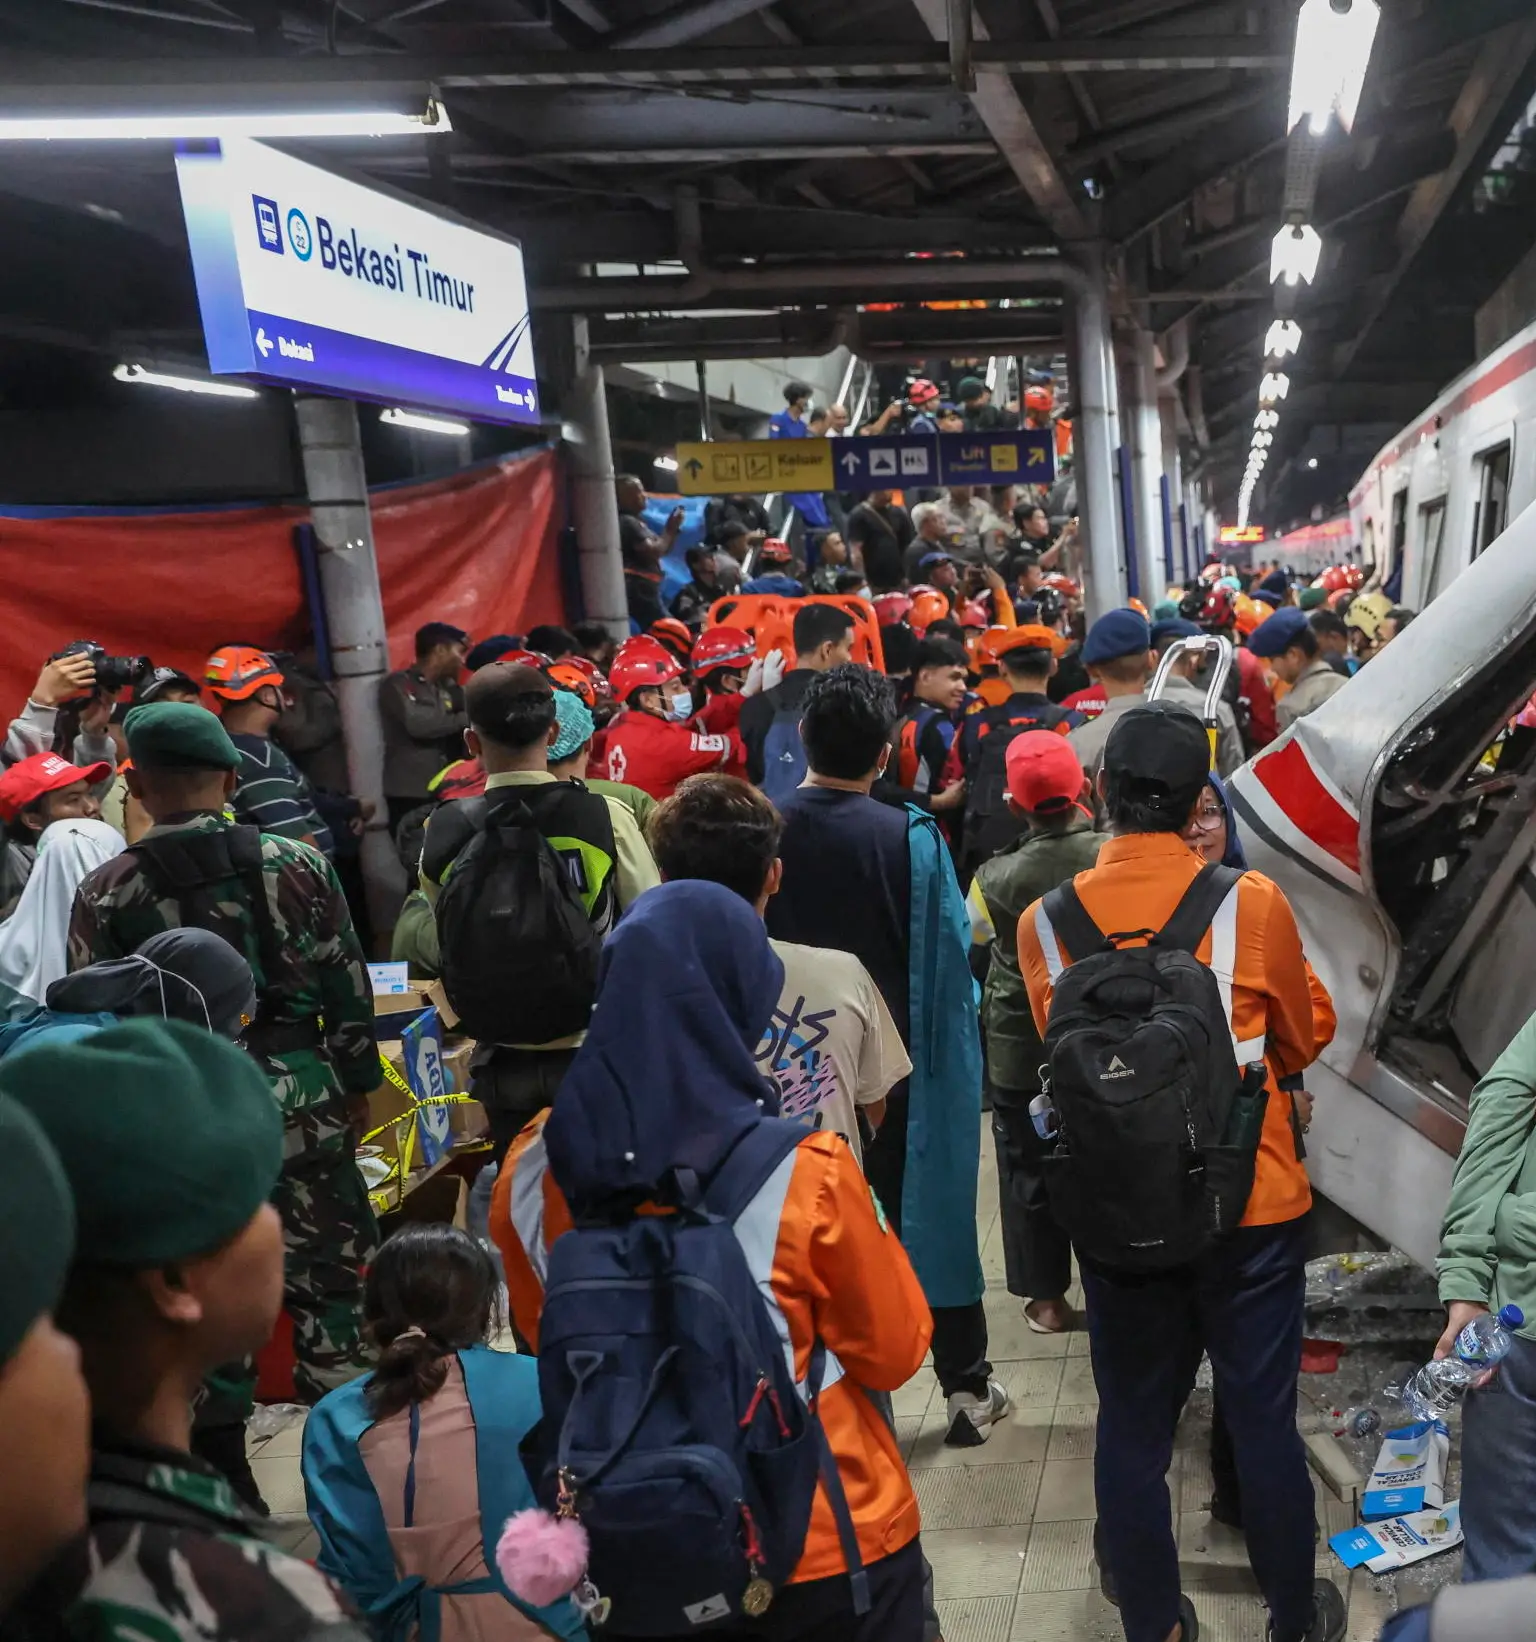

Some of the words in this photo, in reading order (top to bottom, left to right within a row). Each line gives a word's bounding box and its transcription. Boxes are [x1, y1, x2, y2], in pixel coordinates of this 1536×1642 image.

[315, 216, 405, 293] Bekasi
[407, 248, 474, 313] Timur
[1376, 1475, 1422, 1485] CERVICAL
[1380, 1523, 1407, 1548] CERVICAL
[1393, 1525, 1416, 1546] COLLAR
